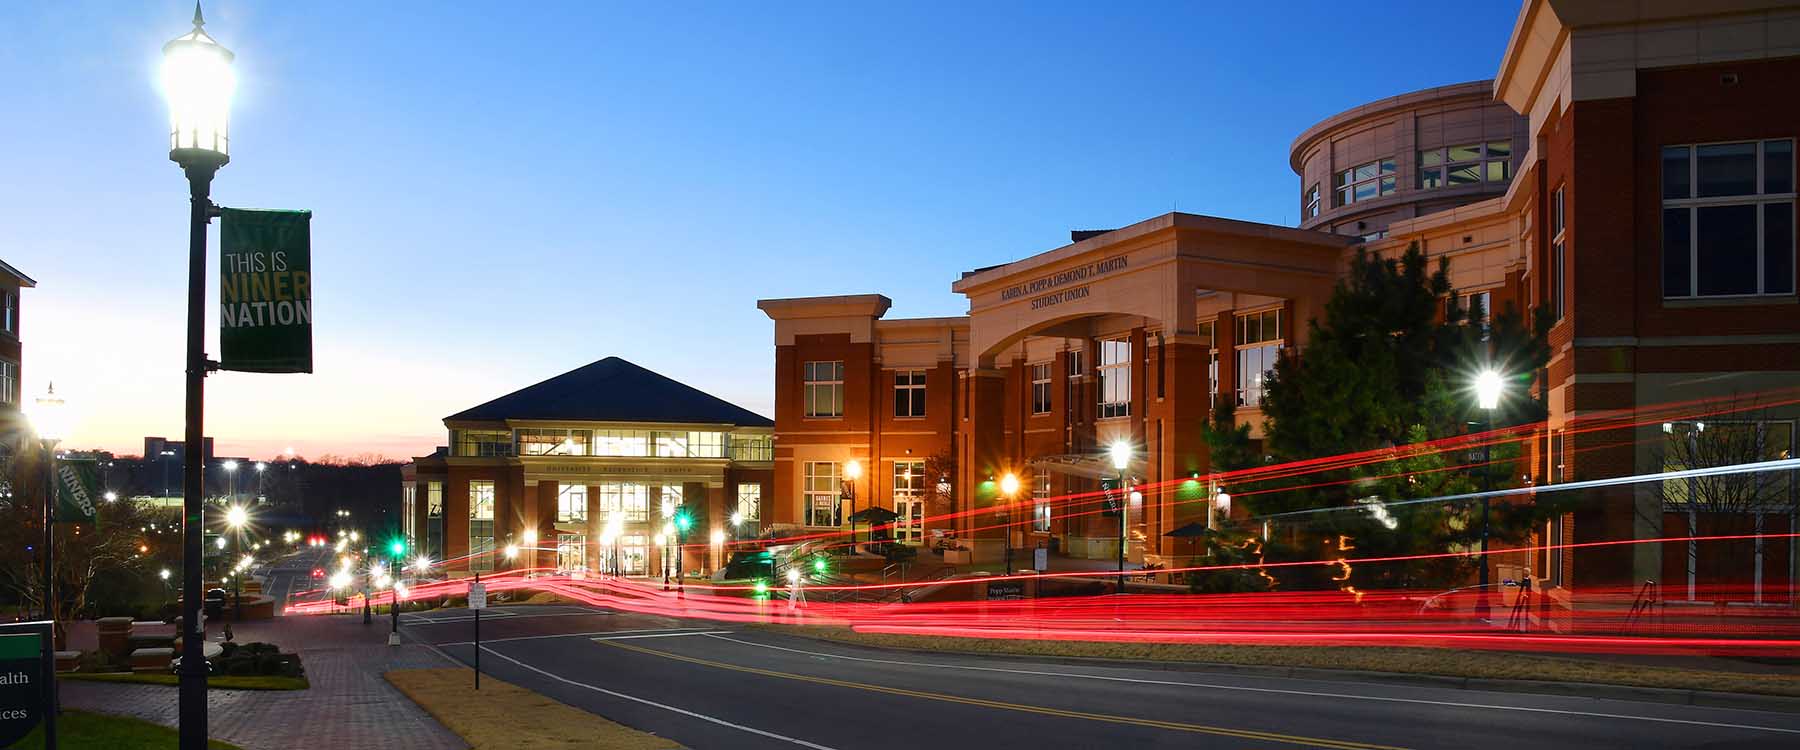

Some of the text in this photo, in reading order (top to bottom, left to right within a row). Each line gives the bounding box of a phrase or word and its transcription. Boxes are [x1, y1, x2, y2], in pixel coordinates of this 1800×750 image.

[226, 250, 287, 272] THIS IS
[221, 270, 311, 303] NINER
[1002, 286, 1022, 300] KAREN
[1030, 279, 1048, 293] POPP
[1054, 268, 1087, 287] DEMOND
[1087, 264, 1096, 277] T.
[1096, 256, 1128, 274] MARTIN
[1031, 287, 1089, 310] STUDENT UNION
[221, 300, 312, 328] NATION
[59, 464, 97, 517] NINERS
